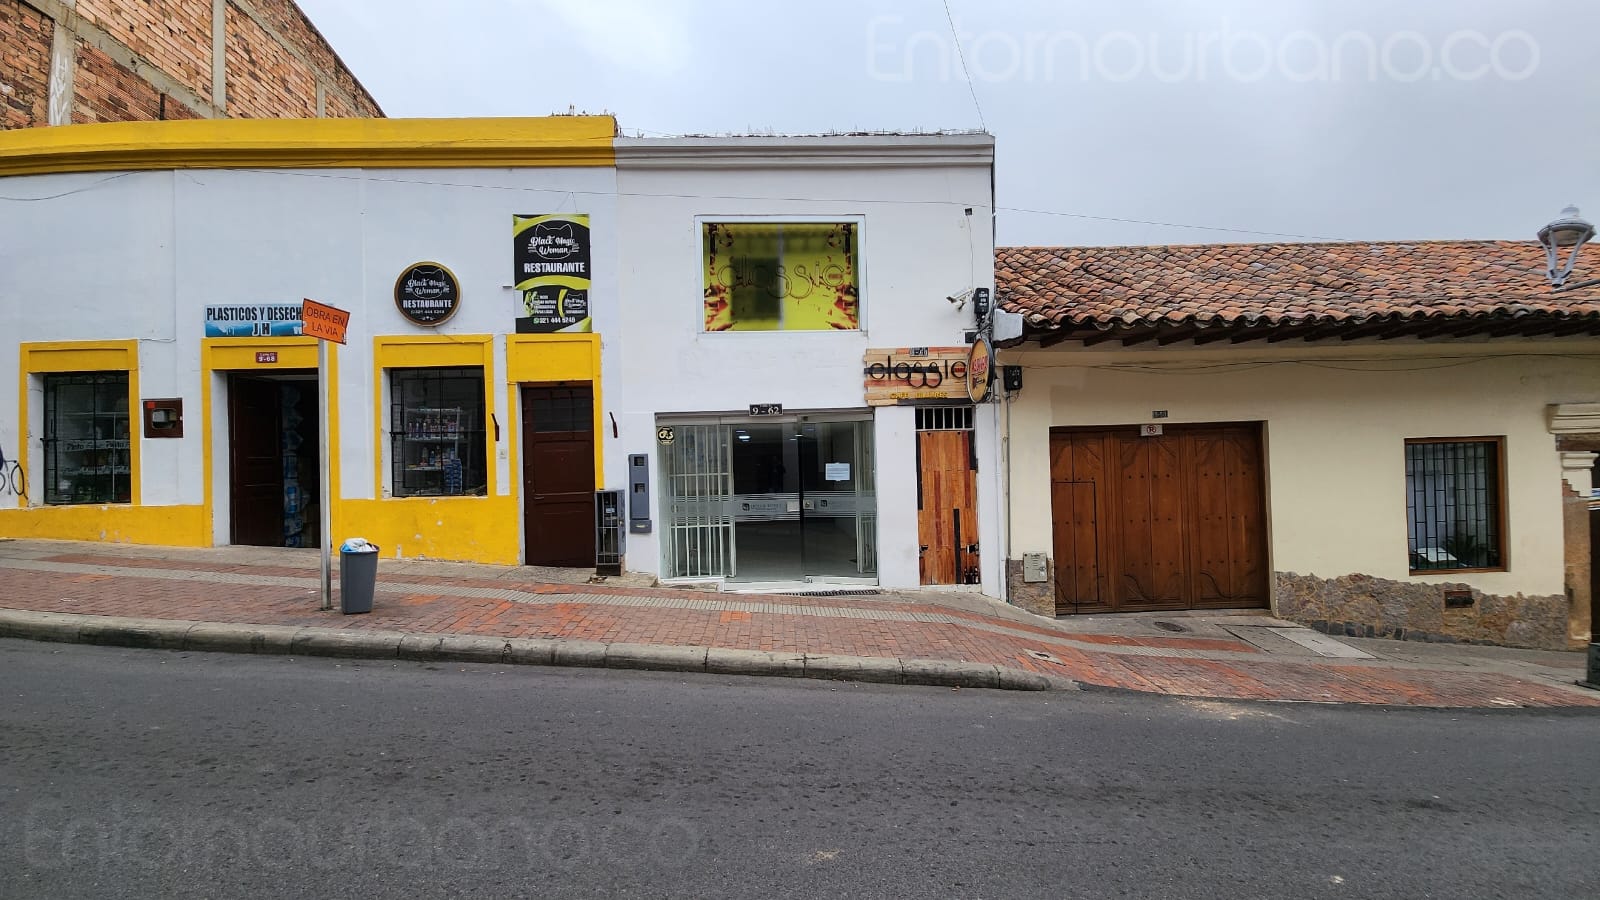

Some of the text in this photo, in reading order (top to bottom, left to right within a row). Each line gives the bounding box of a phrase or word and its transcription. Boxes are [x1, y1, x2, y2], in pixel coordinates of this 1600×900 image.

[530, 235, 554, 247] Black
[539, 246, 569, 255] Woman
[523, 262, 585, 273] RESTAURANTE
[402, 299, 452, 309] RESTAURANTE
[206, 306, 302, 321] PLASTICOS Y DESECH
[306, 306, 345, 327] OBRA EN
[311, 321, 323, 333] LA
[325, 325, 338, 337] VIA
